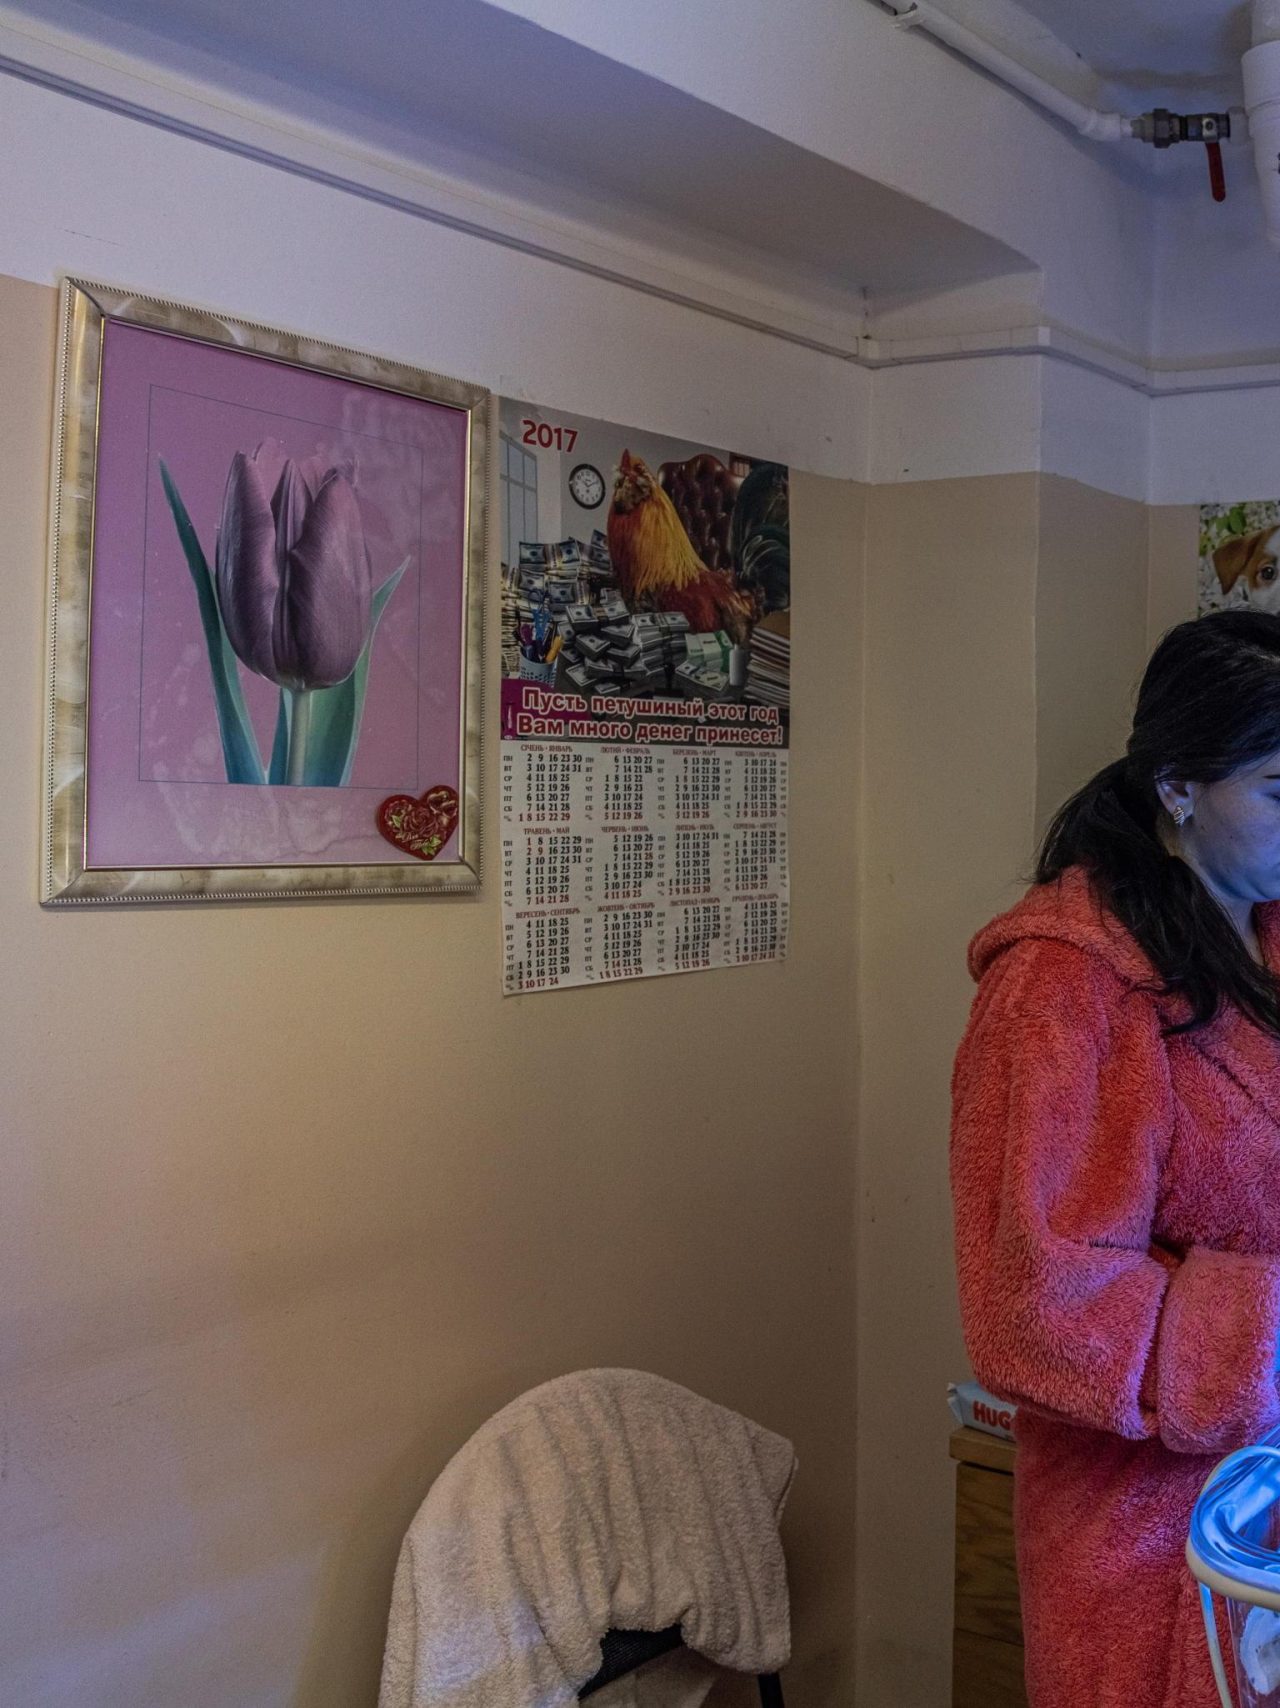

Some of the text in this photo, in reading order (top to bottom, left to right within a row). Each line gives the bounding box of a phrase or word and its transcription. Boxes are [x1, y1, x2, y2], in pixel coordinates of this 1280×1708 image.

[522, 419, 578, 452] 2017
[524, 688, 778, 725] Пусть петушиный этот год
[519, 715, 783, 745] Вам много денег принесет!
[527, 753, 532, 761] 2
[538, 753, 543, 761] 9
[549, 753, 558, 762] 16
[560, 754, 570, 762] 23
[572, 754, 582, 762] 30
[527, 763, 531, 771] 3
[536, 763, 545, 771] 10
[548, 763, 557, 771] 17
[560, 763, 569, 771] 24
[572, 763, 581, 772] 31
[527, 773, 531, 781] 4
[535, 773, 544, 781] 11
[548, 773, 557, 781] 18
[560, 773, 569, 781] 25
[527, 783, 531, 791] 5
[535, 783, 544, 791] 12
[548, 783, 557, 791] 19
[560, 783, 569, 791] 26
[527, 793, 531, 801] 6
[535, 793, 545, 801] 13
[548, 793, 558, 801] 20
[560, 793, 569, 801] 27
[527, 803, 532, 811] 7
[536, 803, 545, 811] 14
[548, 803, 557, 811] 21
[519, 812, 570, 821] 1 8 15 22 29
[973, 1401, 1012, 1431] HUG
